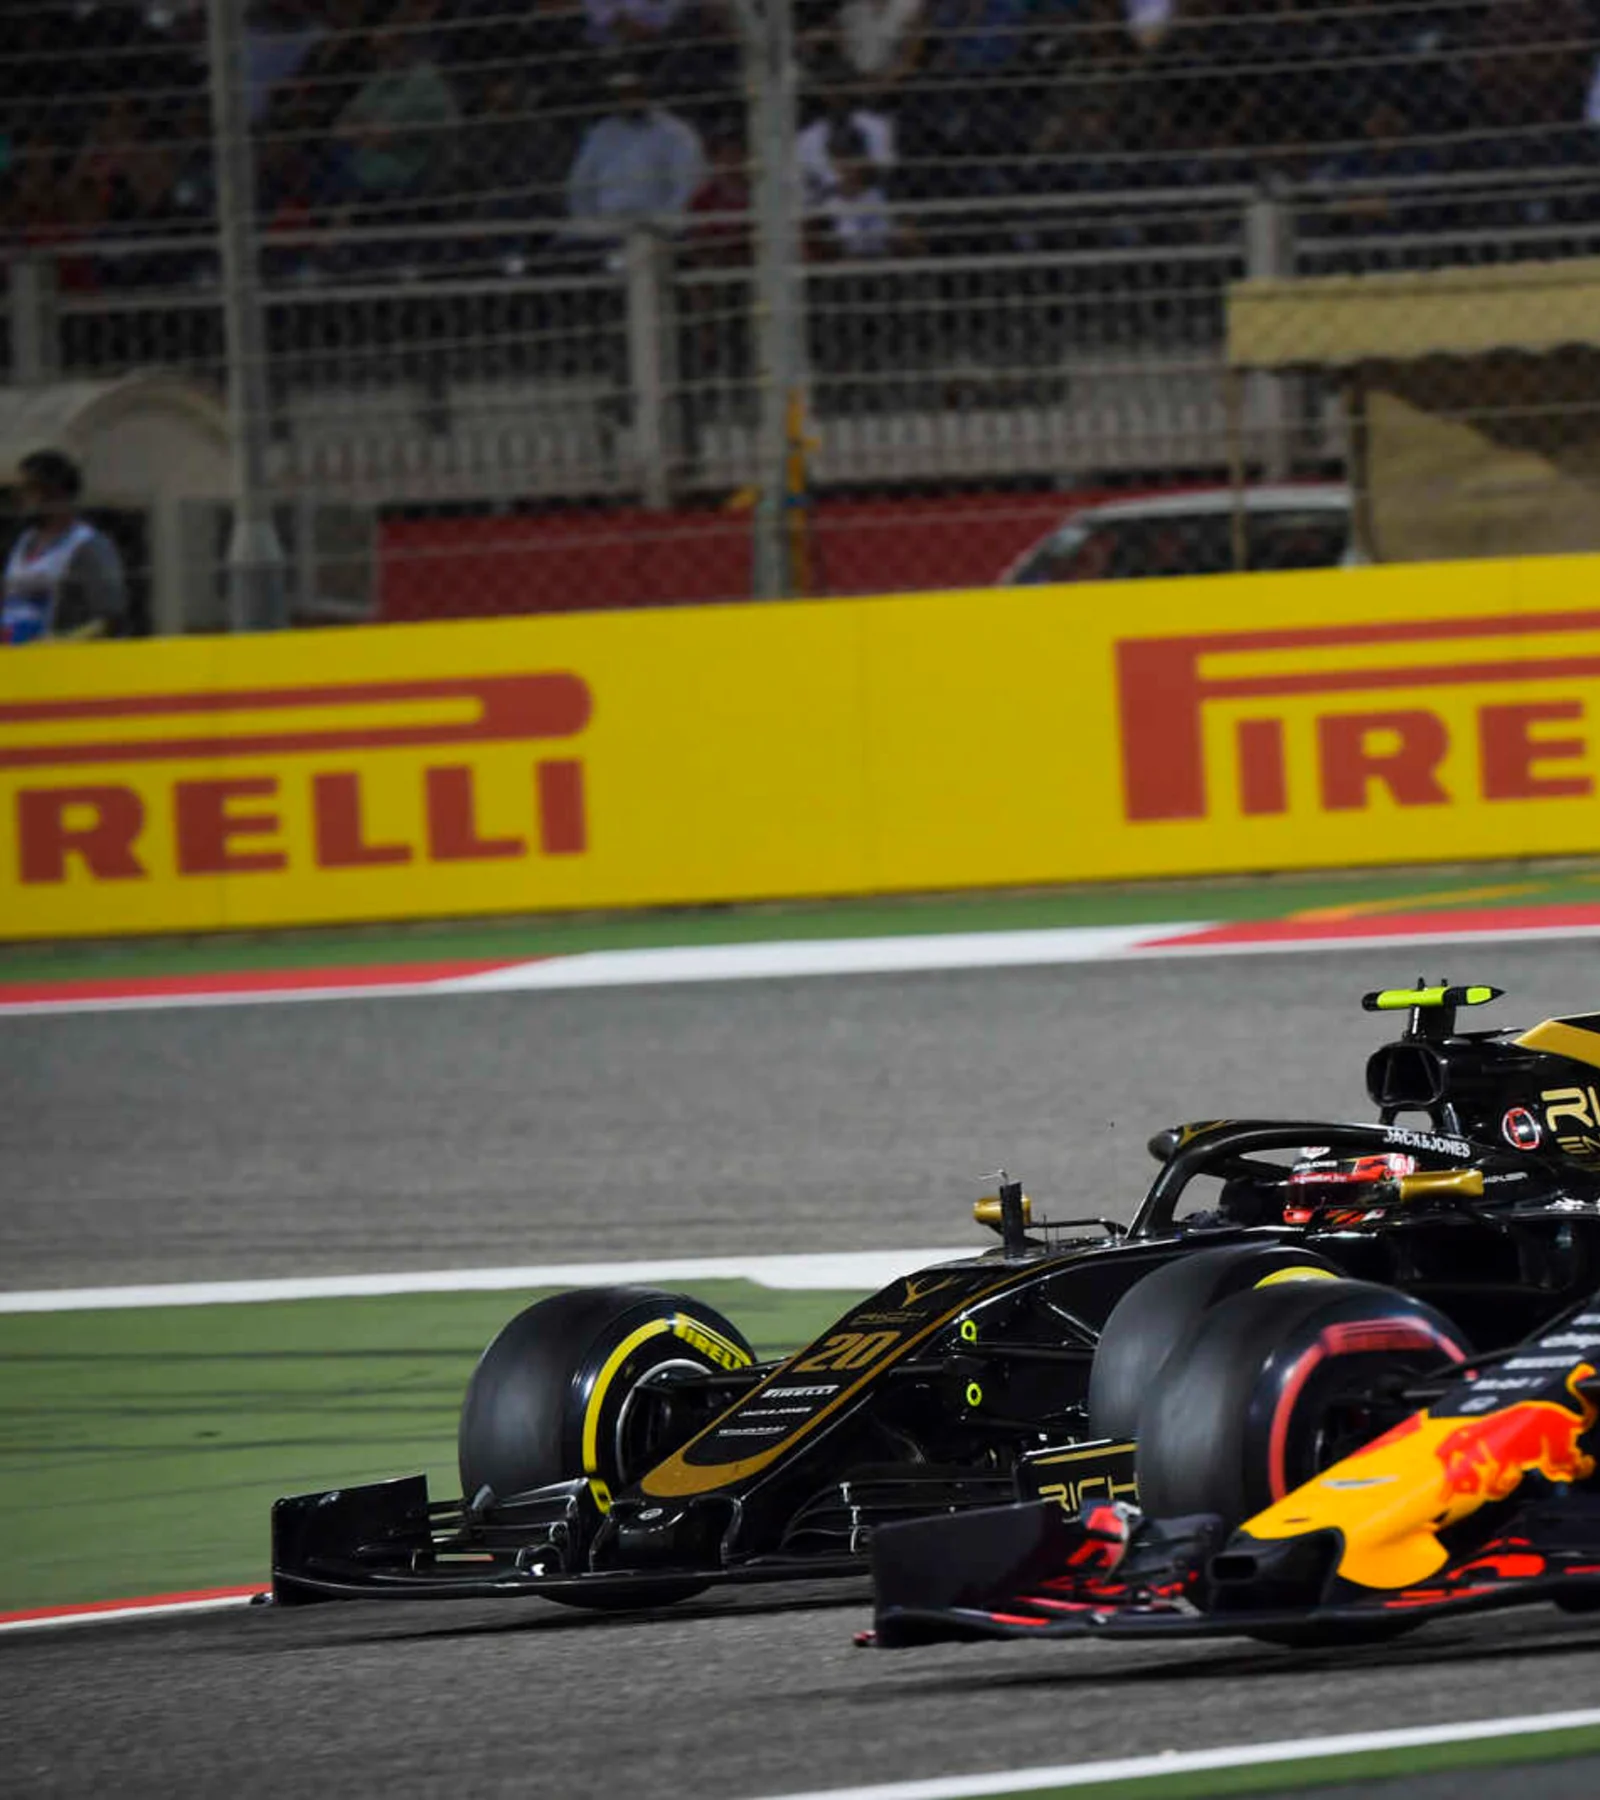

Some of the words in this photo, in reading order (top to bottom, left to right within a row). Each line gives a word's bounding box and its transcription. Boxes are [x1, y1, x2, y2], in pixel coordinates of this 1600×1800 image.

[0, 672, 592, 885] RELLI
[1383, 1128, 1471, 1159] JACK&JONES
[792, 1330, 901, 1373] 20
